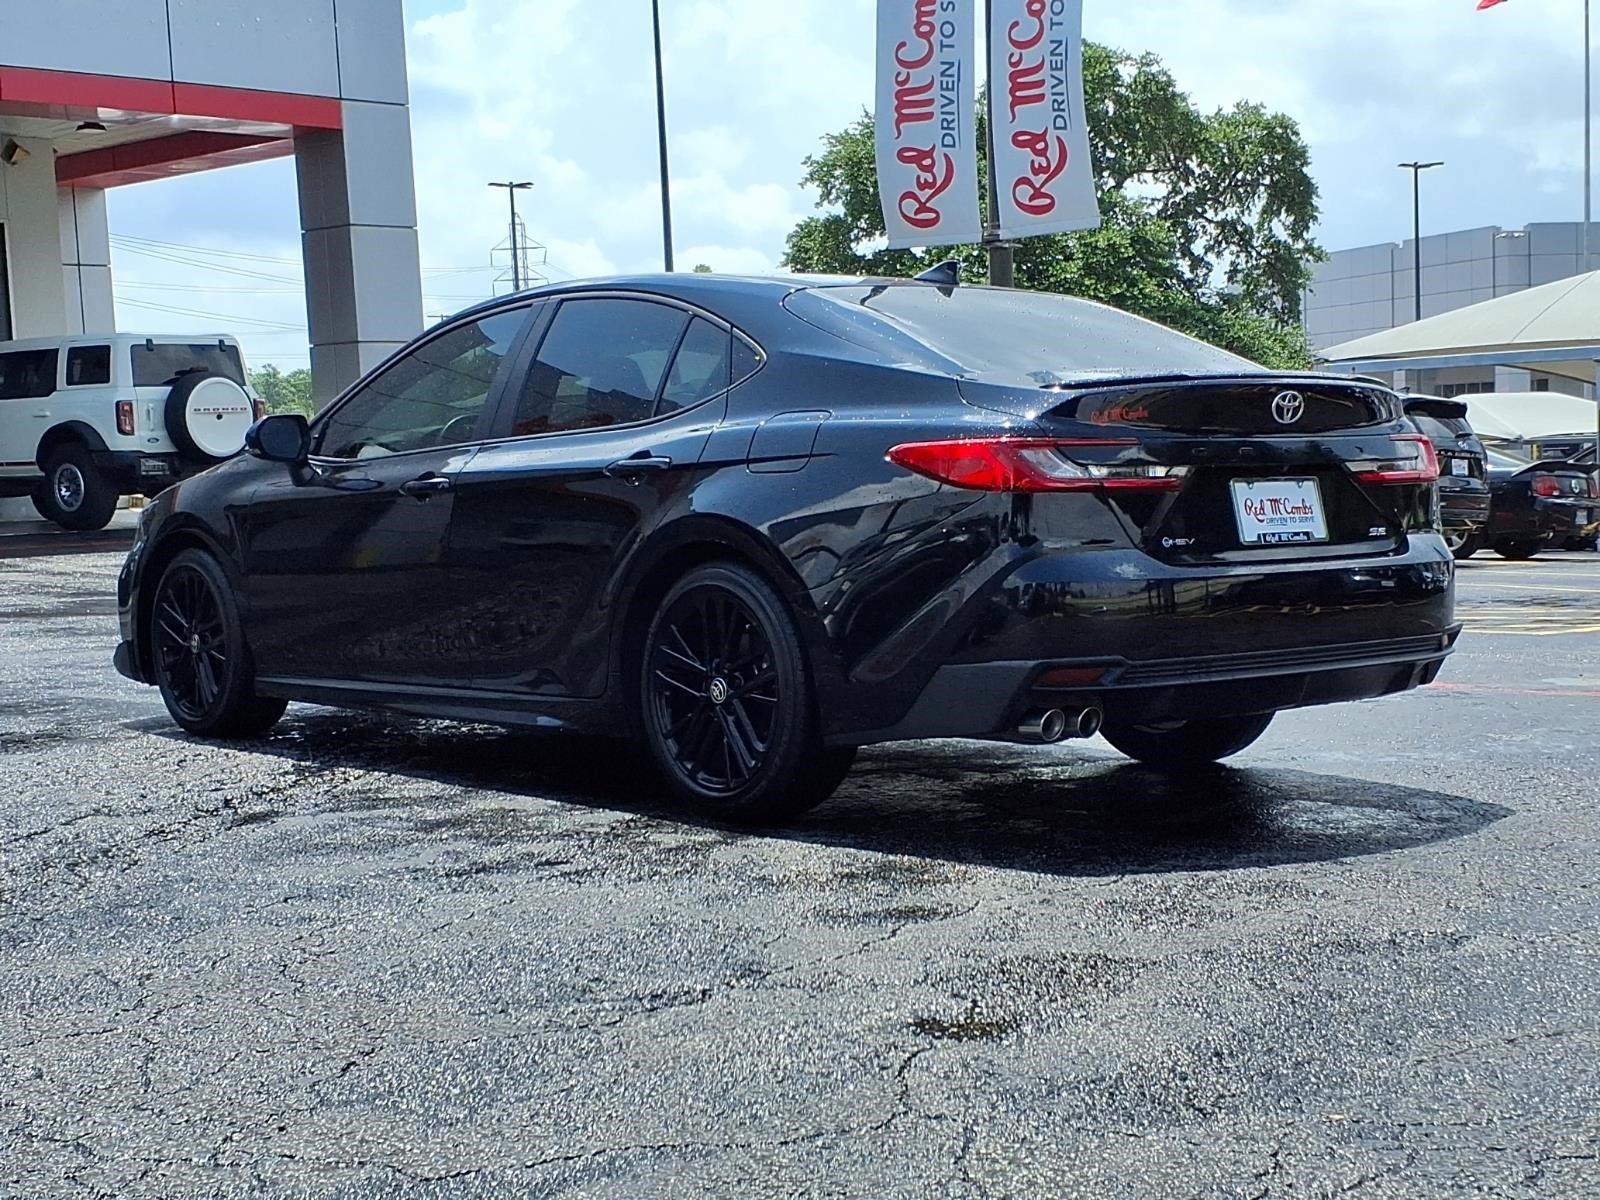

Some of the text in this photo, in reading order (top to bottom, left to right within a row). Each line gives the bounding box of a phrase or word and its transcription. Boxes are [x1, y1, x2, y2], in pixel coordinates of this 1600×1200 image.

[940, 20, 956, 53] TO
[1050, 0, 1068, 131] DRIVEN TO
[940, 60, 956, 149] DRIVEN
[896, 144, 955, 229] Red
[1011, 126, 1068, 216] Red
[1244, 497, 1314, 523] Red McCombs
[1266, 516, 1315, 525] DRIVEN TO SERVE
